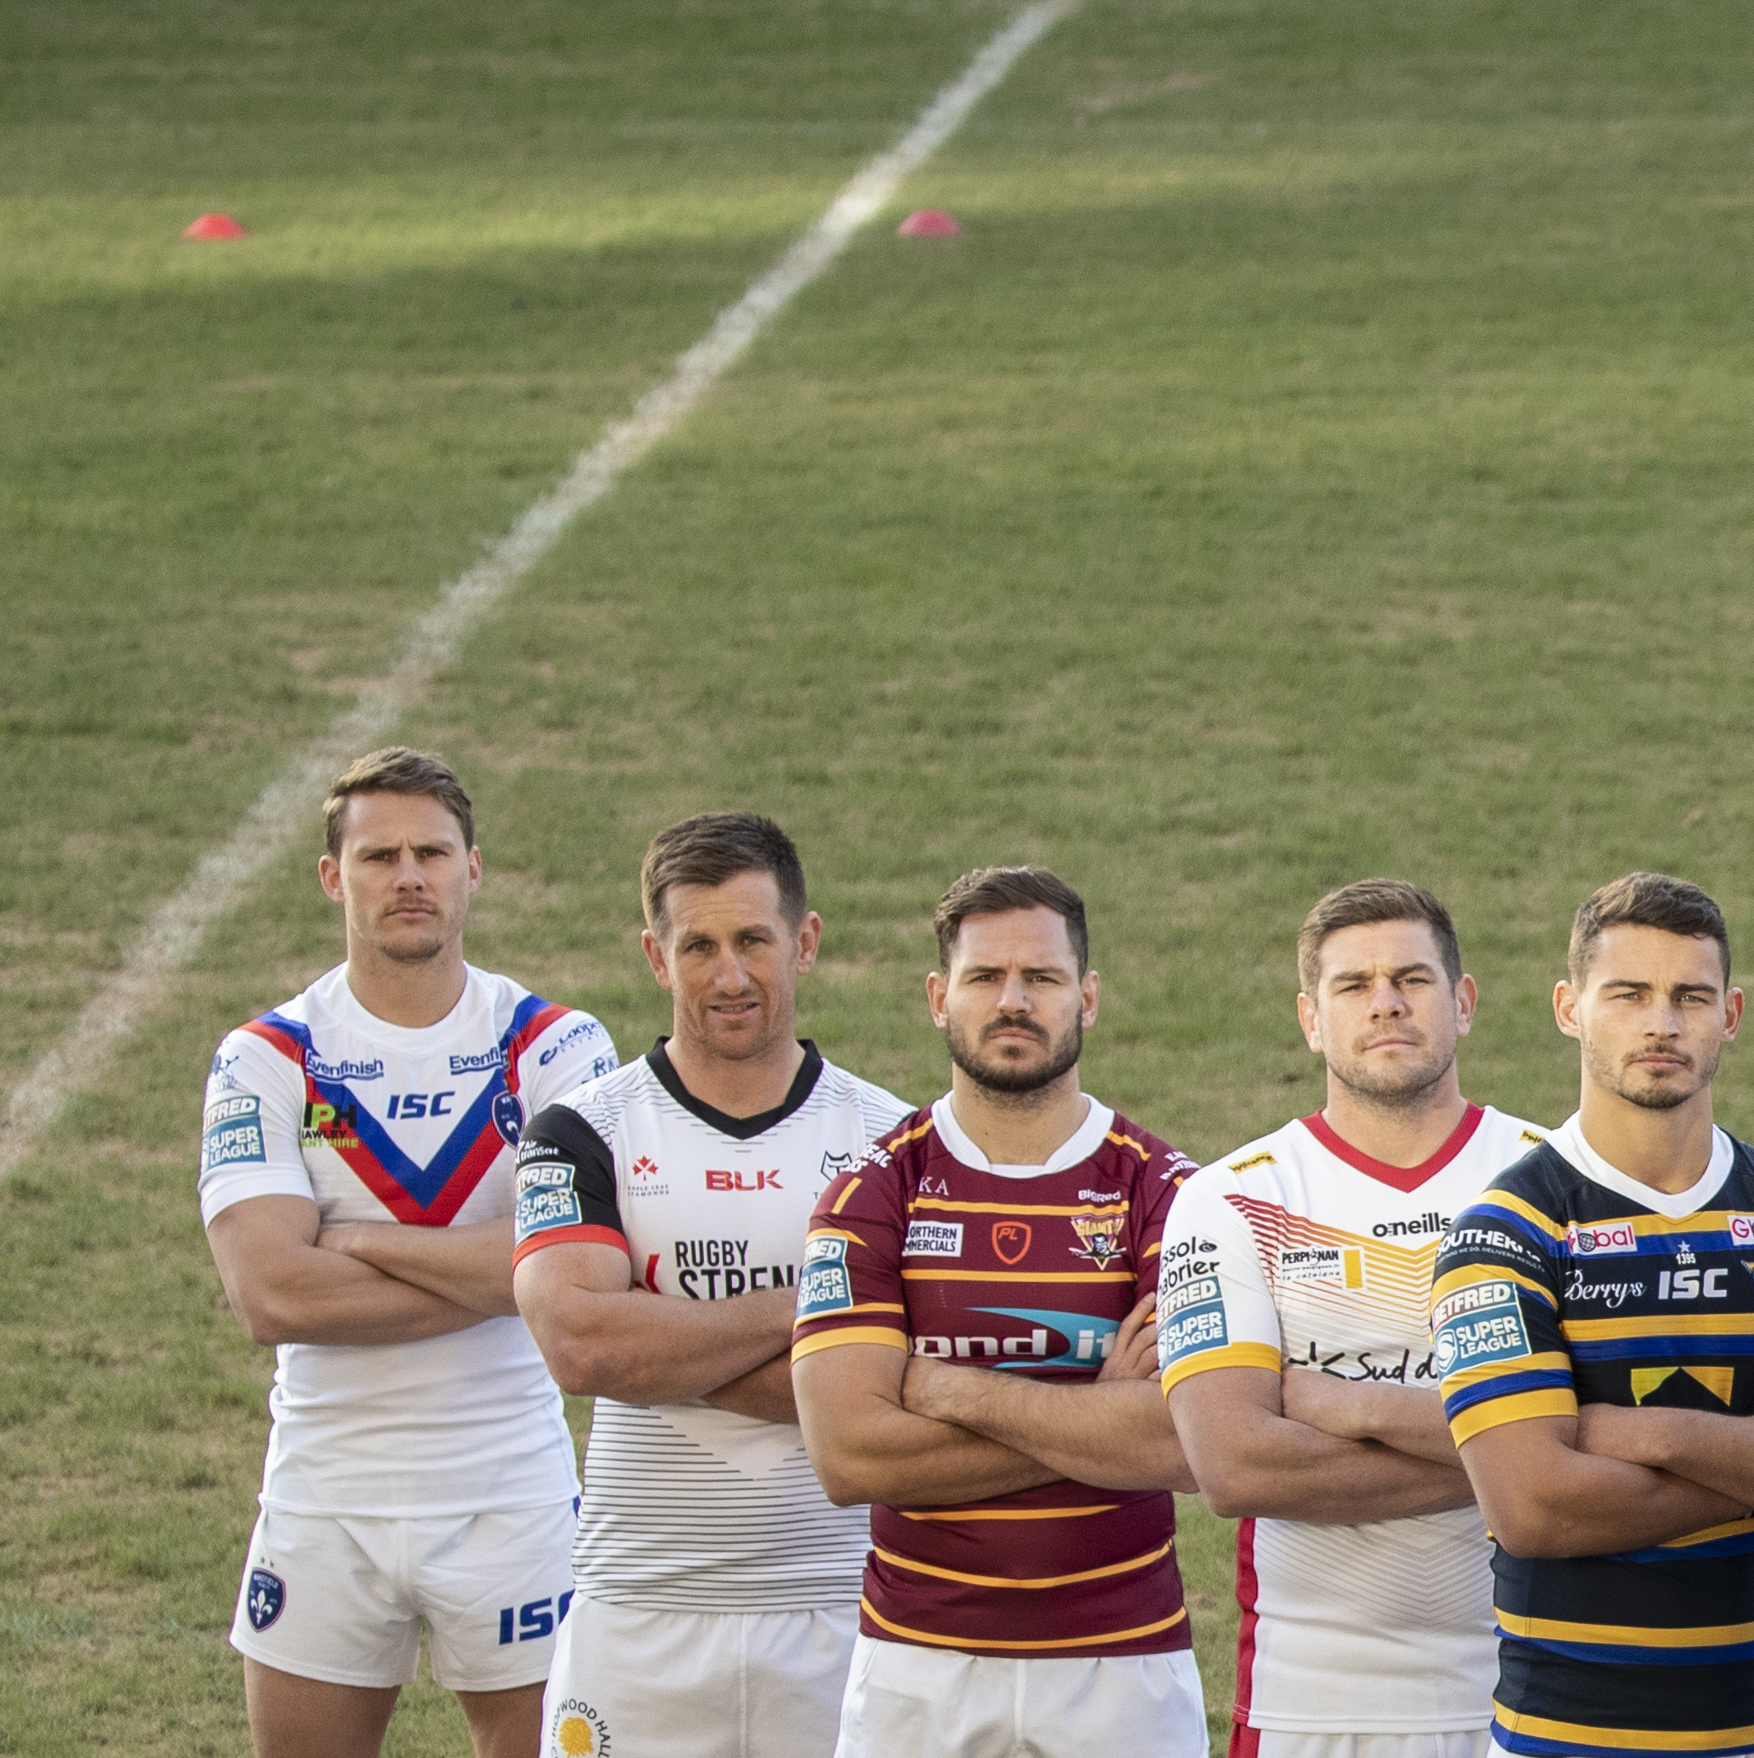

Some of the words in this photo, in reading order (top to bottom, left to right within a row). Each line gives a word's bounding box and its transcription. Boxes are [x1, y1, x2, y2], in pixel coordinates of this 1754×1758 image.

[386, 1091, 456, 1120] ISC
[210, 1125, 260, 1152] SUPER
[210, 1141, 261, 1166] LEAGUE
[705, 1169, 784, 1191] BLK
[520, 1188, 572, 1217] SUPER
[520, 1202, 574, 1229] LEAGUE
[909, 1225, 958, 1240] ORTHERN
[674, 1240, 749, 1268] RUGBY
[1675, 1252, 1697, 1266] 1395
[1658, 1267, 1729, 1300] ISC
[1433, 1283, 1511, 1326] BETFRED
[1167, 1311, 1222, 1342] SUPER
[1455, 1316, 1519, 1345] SUPER
[1167, 1326, 1224, 1356] LEAGUE
[1459, 1332, 1522, 1359] LEAGUE
[596, 1719, 612, 1758] HALL
